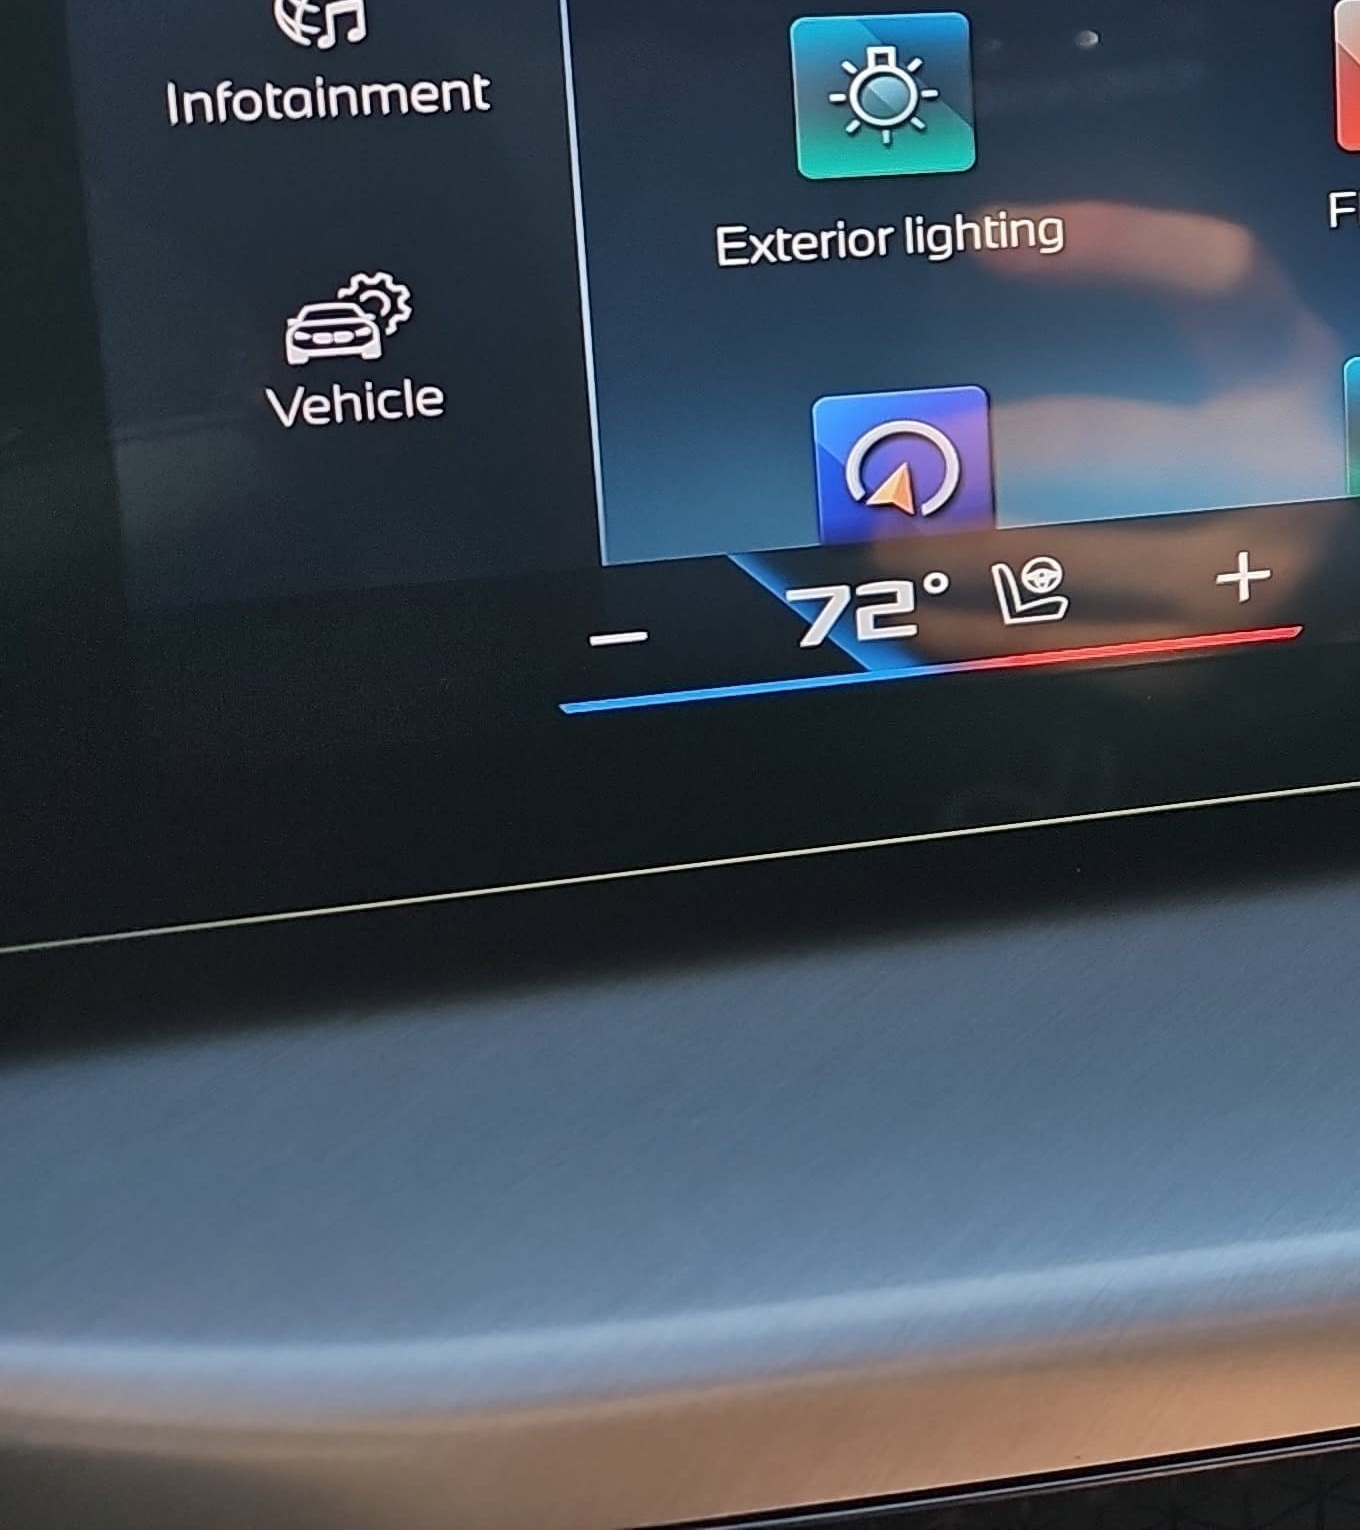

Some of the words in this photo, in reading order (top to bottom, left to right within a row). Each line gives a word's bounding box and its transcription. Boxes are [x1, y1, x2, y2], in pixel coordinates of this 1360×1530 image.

[166, 72, 492, 126] Infotainment
[715, 219, 896, 267] Exterior
[904, 210, 1065, 262] lighting
[264, 377, 445, 428] Vehicle
